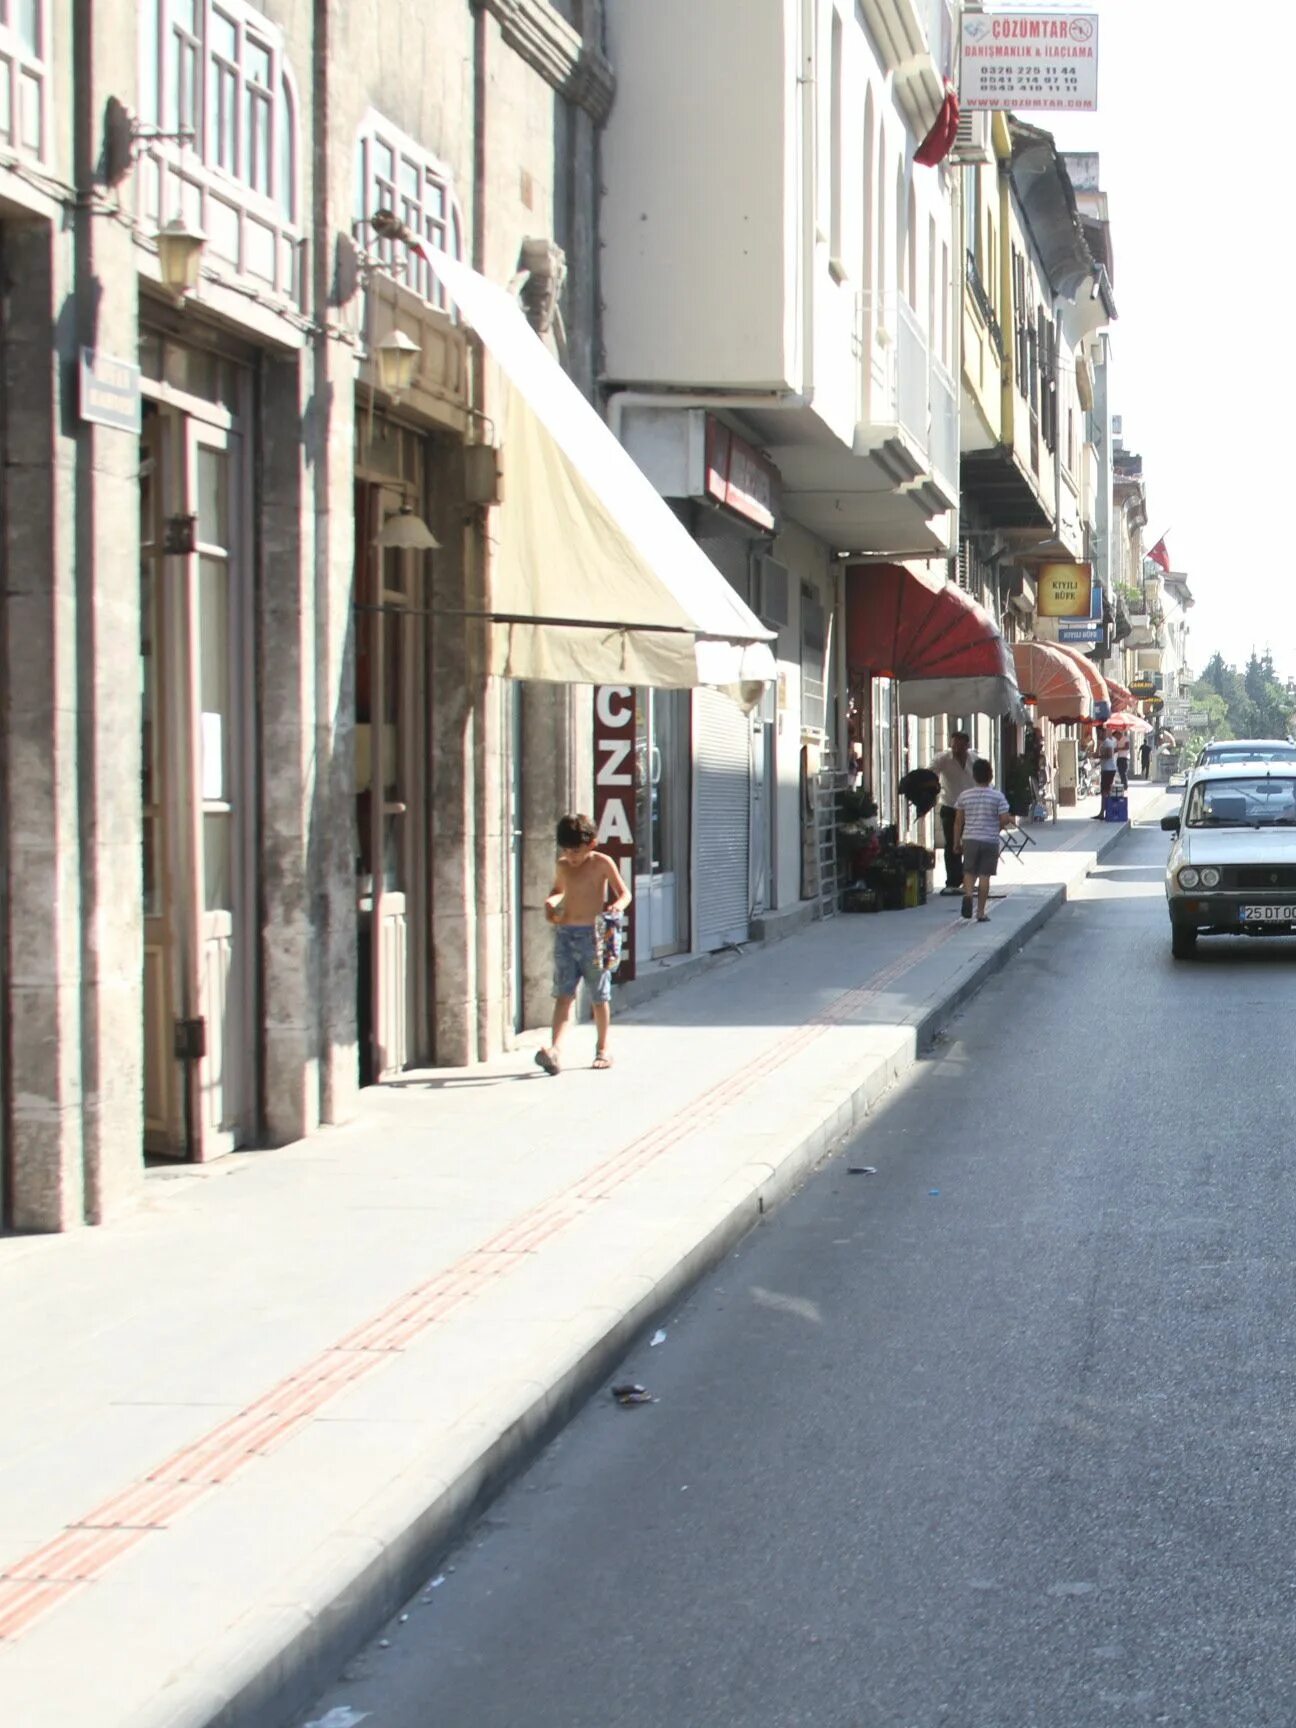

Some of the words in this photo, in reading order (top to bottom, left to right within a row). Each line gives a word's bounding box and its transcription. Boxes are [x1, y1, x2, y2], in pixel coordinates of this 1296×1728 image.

[992, 18, 1068, 40] ÇÖZÜMTAR
[1045, 45, 1093, 57] İLAÇLAMA
[981, 66, 1013, 75] 0326
[1017, 66, 1040, 75] 225
[1045, 66, 1057, 75] 11
[1060, 66, 1076, 75] 44
[1246, 907, 1262, 920] 25
[1264, 907, 1280, 919] DT
